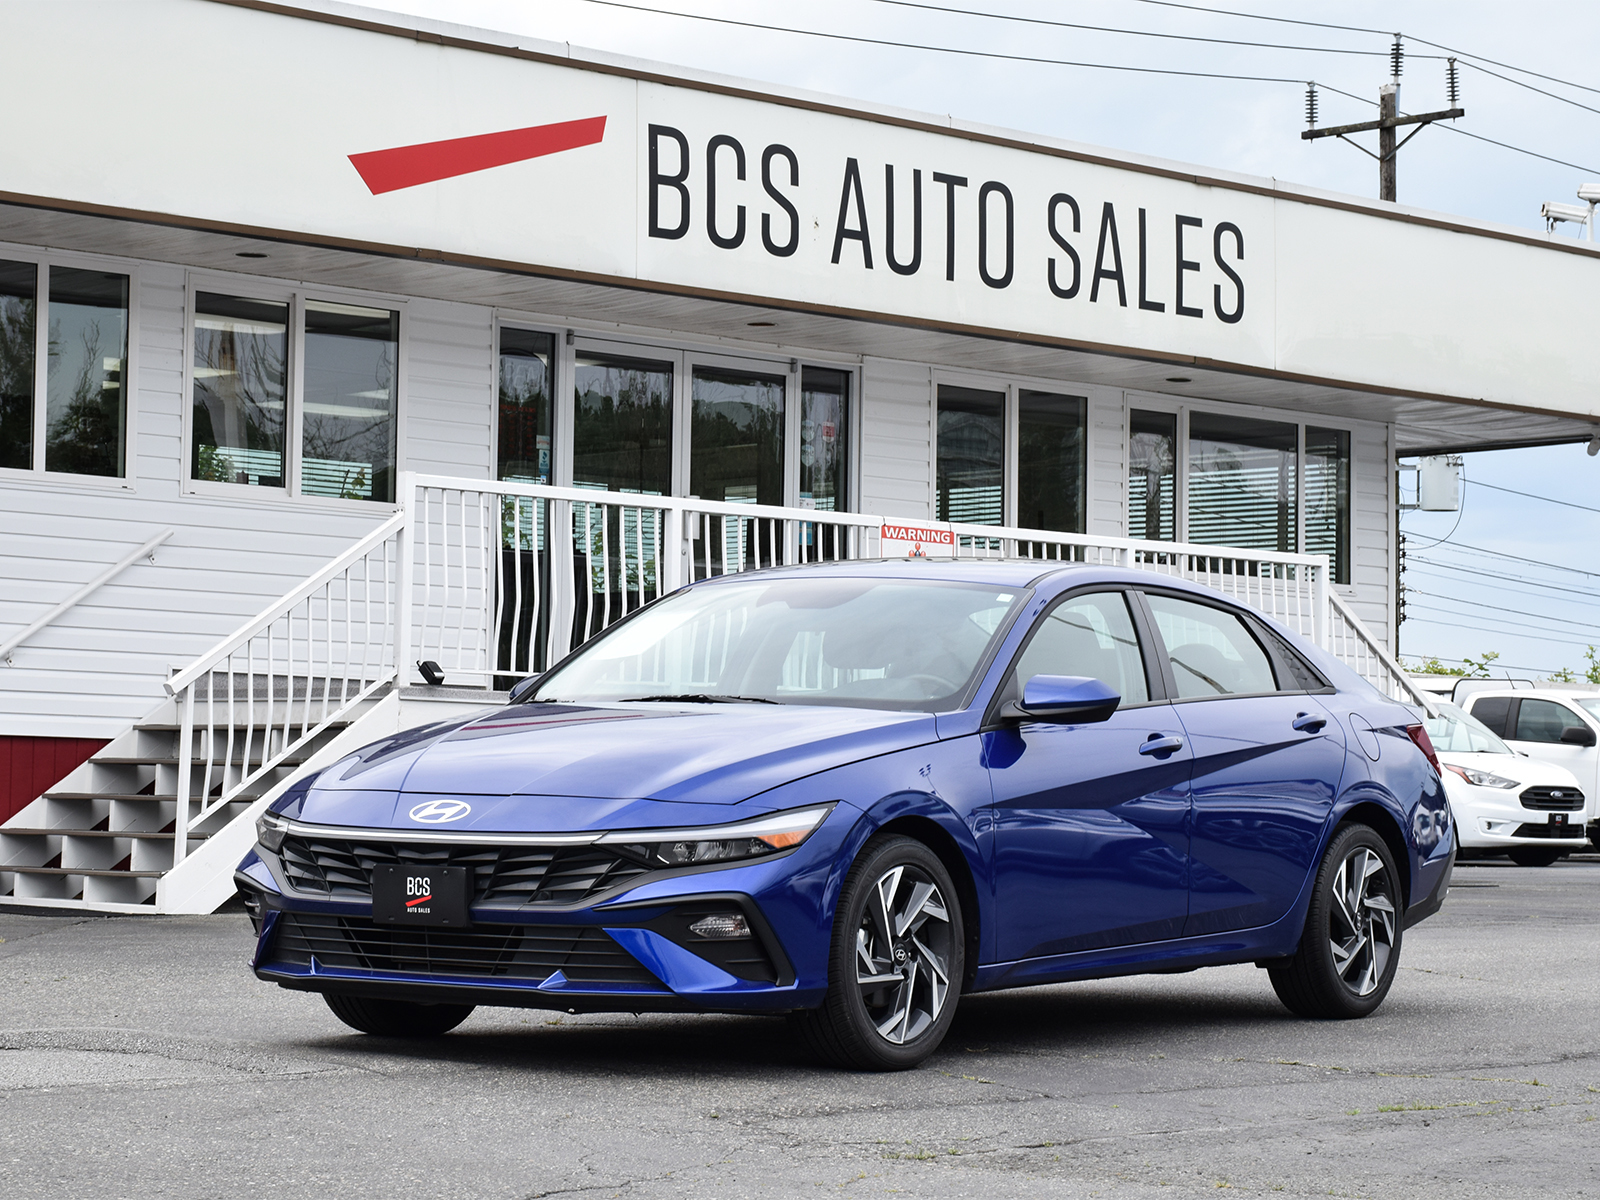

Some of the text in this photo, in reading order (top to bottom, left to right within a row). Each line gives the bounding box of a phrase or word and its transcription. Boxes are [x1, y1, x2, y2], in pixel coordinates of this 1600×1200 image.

[648, 123, 1245, 324] BCS AUTO SALES
[884, 526, 951, 543] WARNING
[407, 877, 430, 895] BCS
